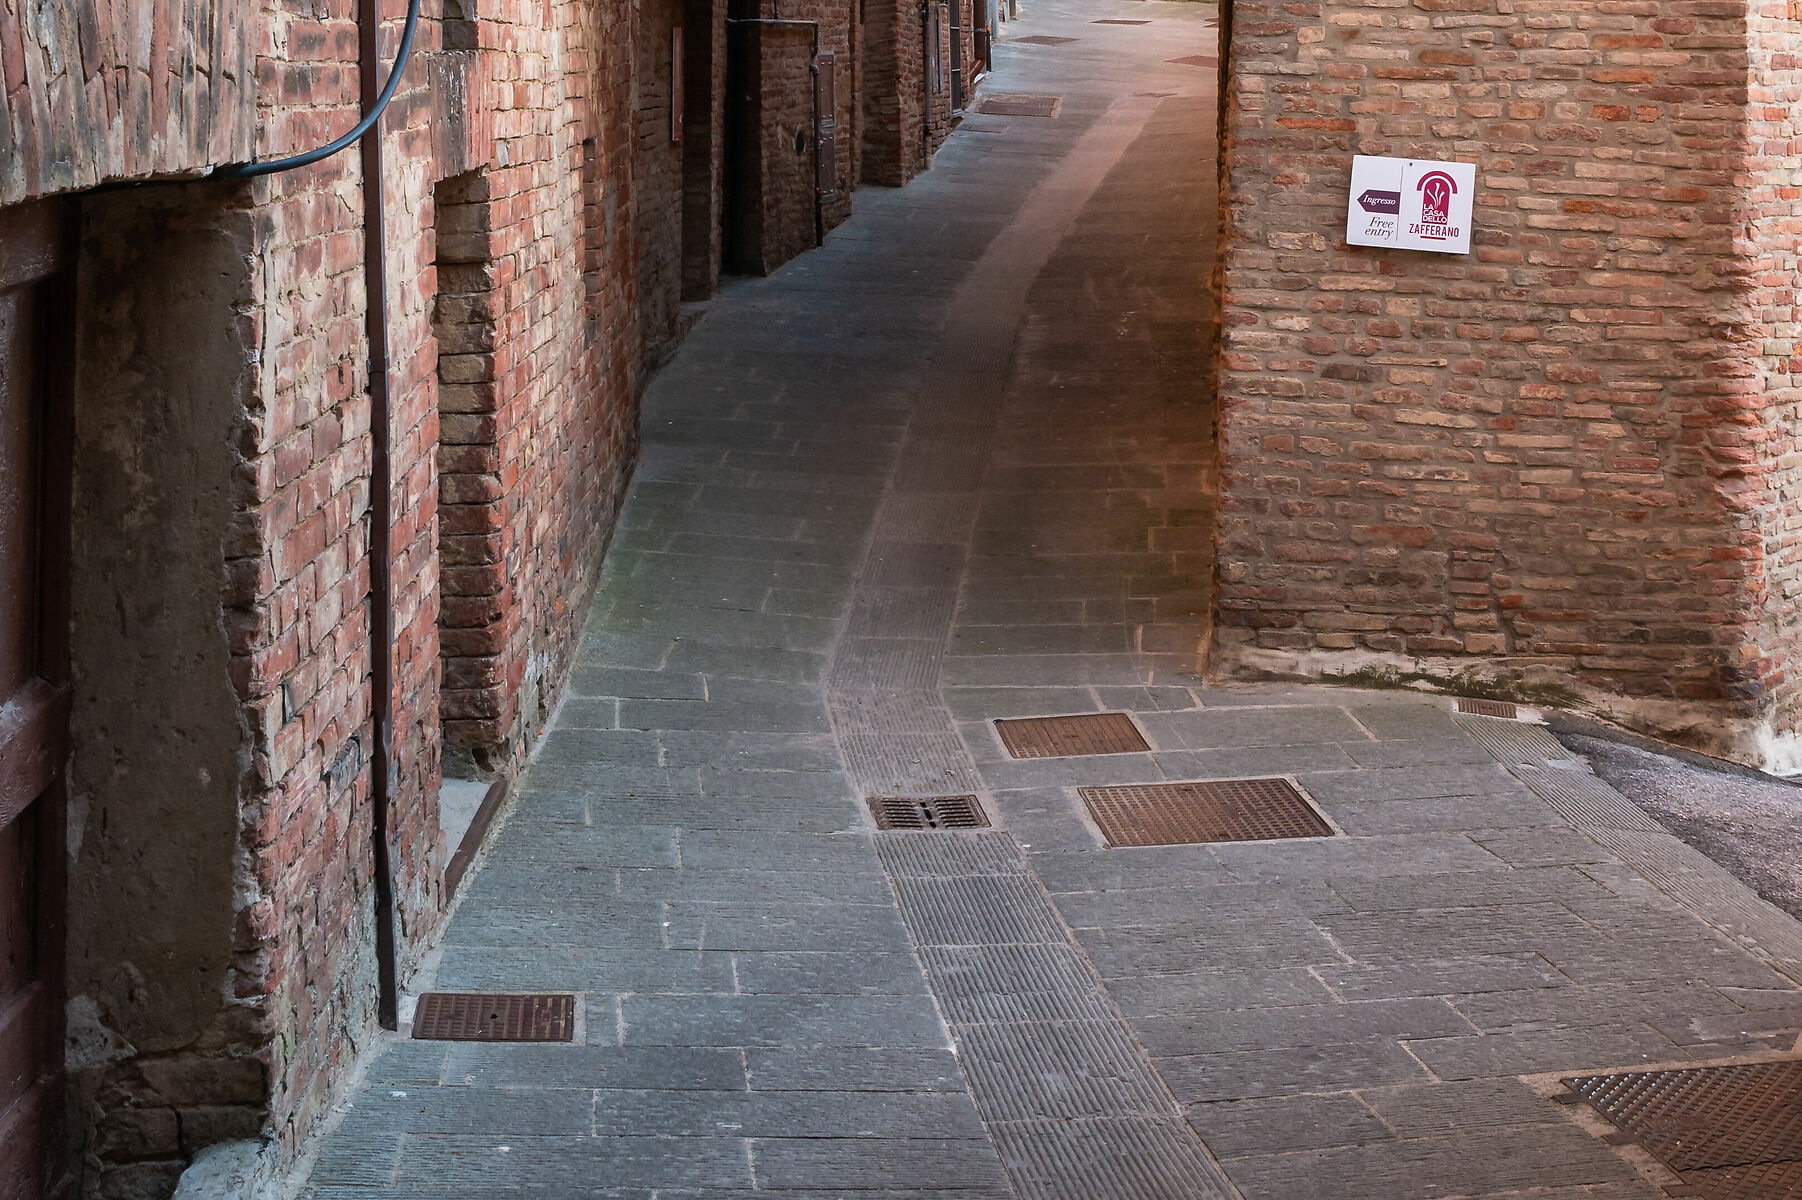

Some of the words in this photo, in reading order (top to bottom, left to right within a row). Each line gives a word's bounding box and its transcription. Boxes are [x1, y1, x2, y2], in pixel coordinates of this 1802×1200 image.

[1363, 195, 1396, 206] Ingresso
[1423, 203, 1434, 211] LA
[1369, 216, 1394, 229] Free
[1422, 215, 1448, 224] DELLO
[1364, 227, 1394, 240] entry
[1409, 224, 1459, 237] ZAFFERANO
